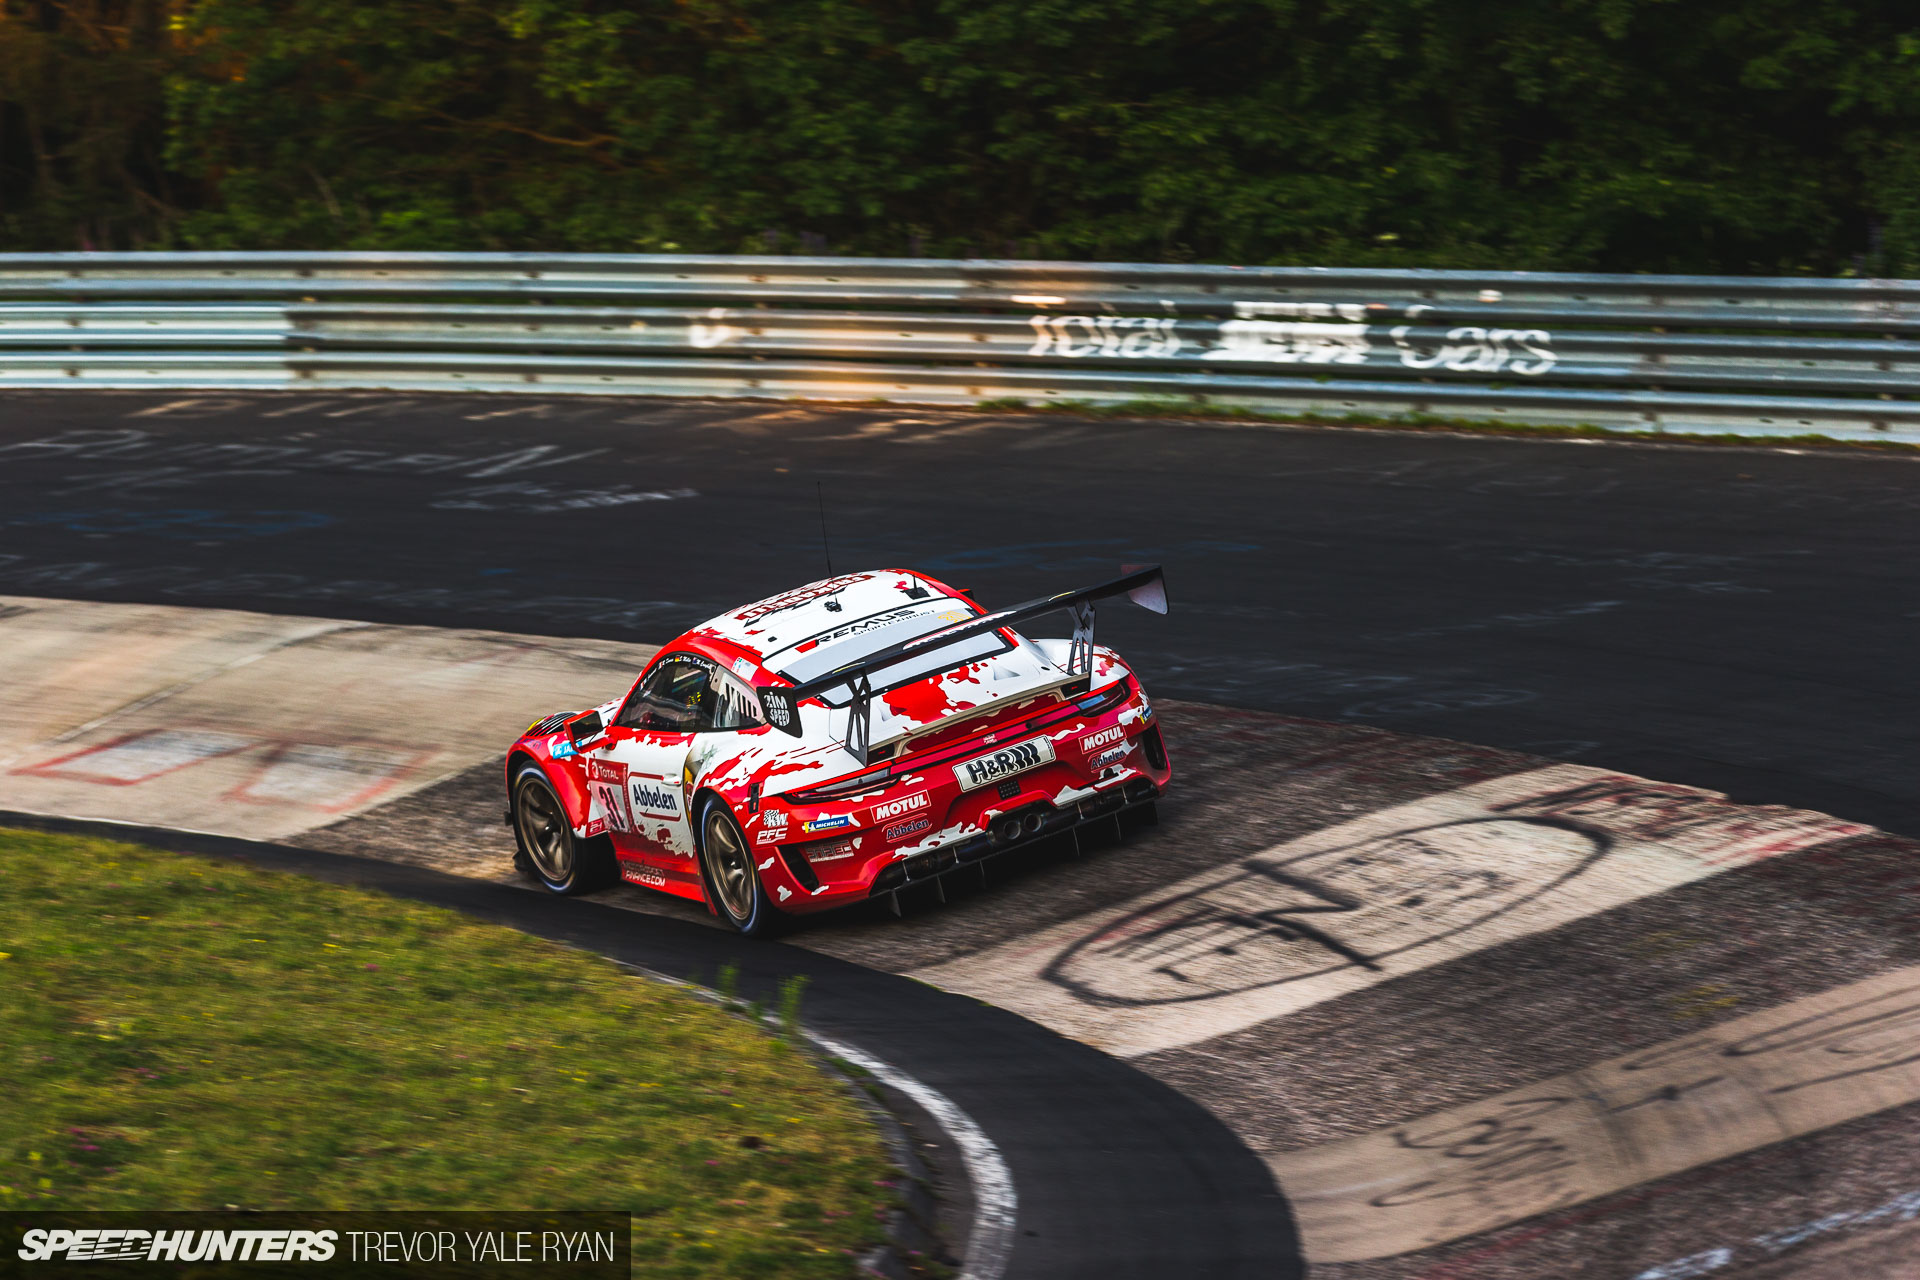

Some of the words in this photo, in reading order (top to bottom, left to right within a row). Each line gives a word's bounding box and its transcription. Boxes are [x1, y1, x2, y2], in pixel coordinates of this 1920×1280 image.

[816, 609, 915, 646] REMUS
[769, 708, 790, 727] SPEED
[1083, 726, 1124, 751] MOTUL
[965, 748, 1022, 784] H&R
[1090, 749, 1126, 770] Abbelen
[598, 786, 626, 831] 31
[632, 783, 678, 811] Abbelen
[876, 794, 927, 820] MOTUL
[757, 827, 788, 840] PFC
[815, 819, 845, 829] MICHELIN
[886, 819, 930, 840] Abbelen
